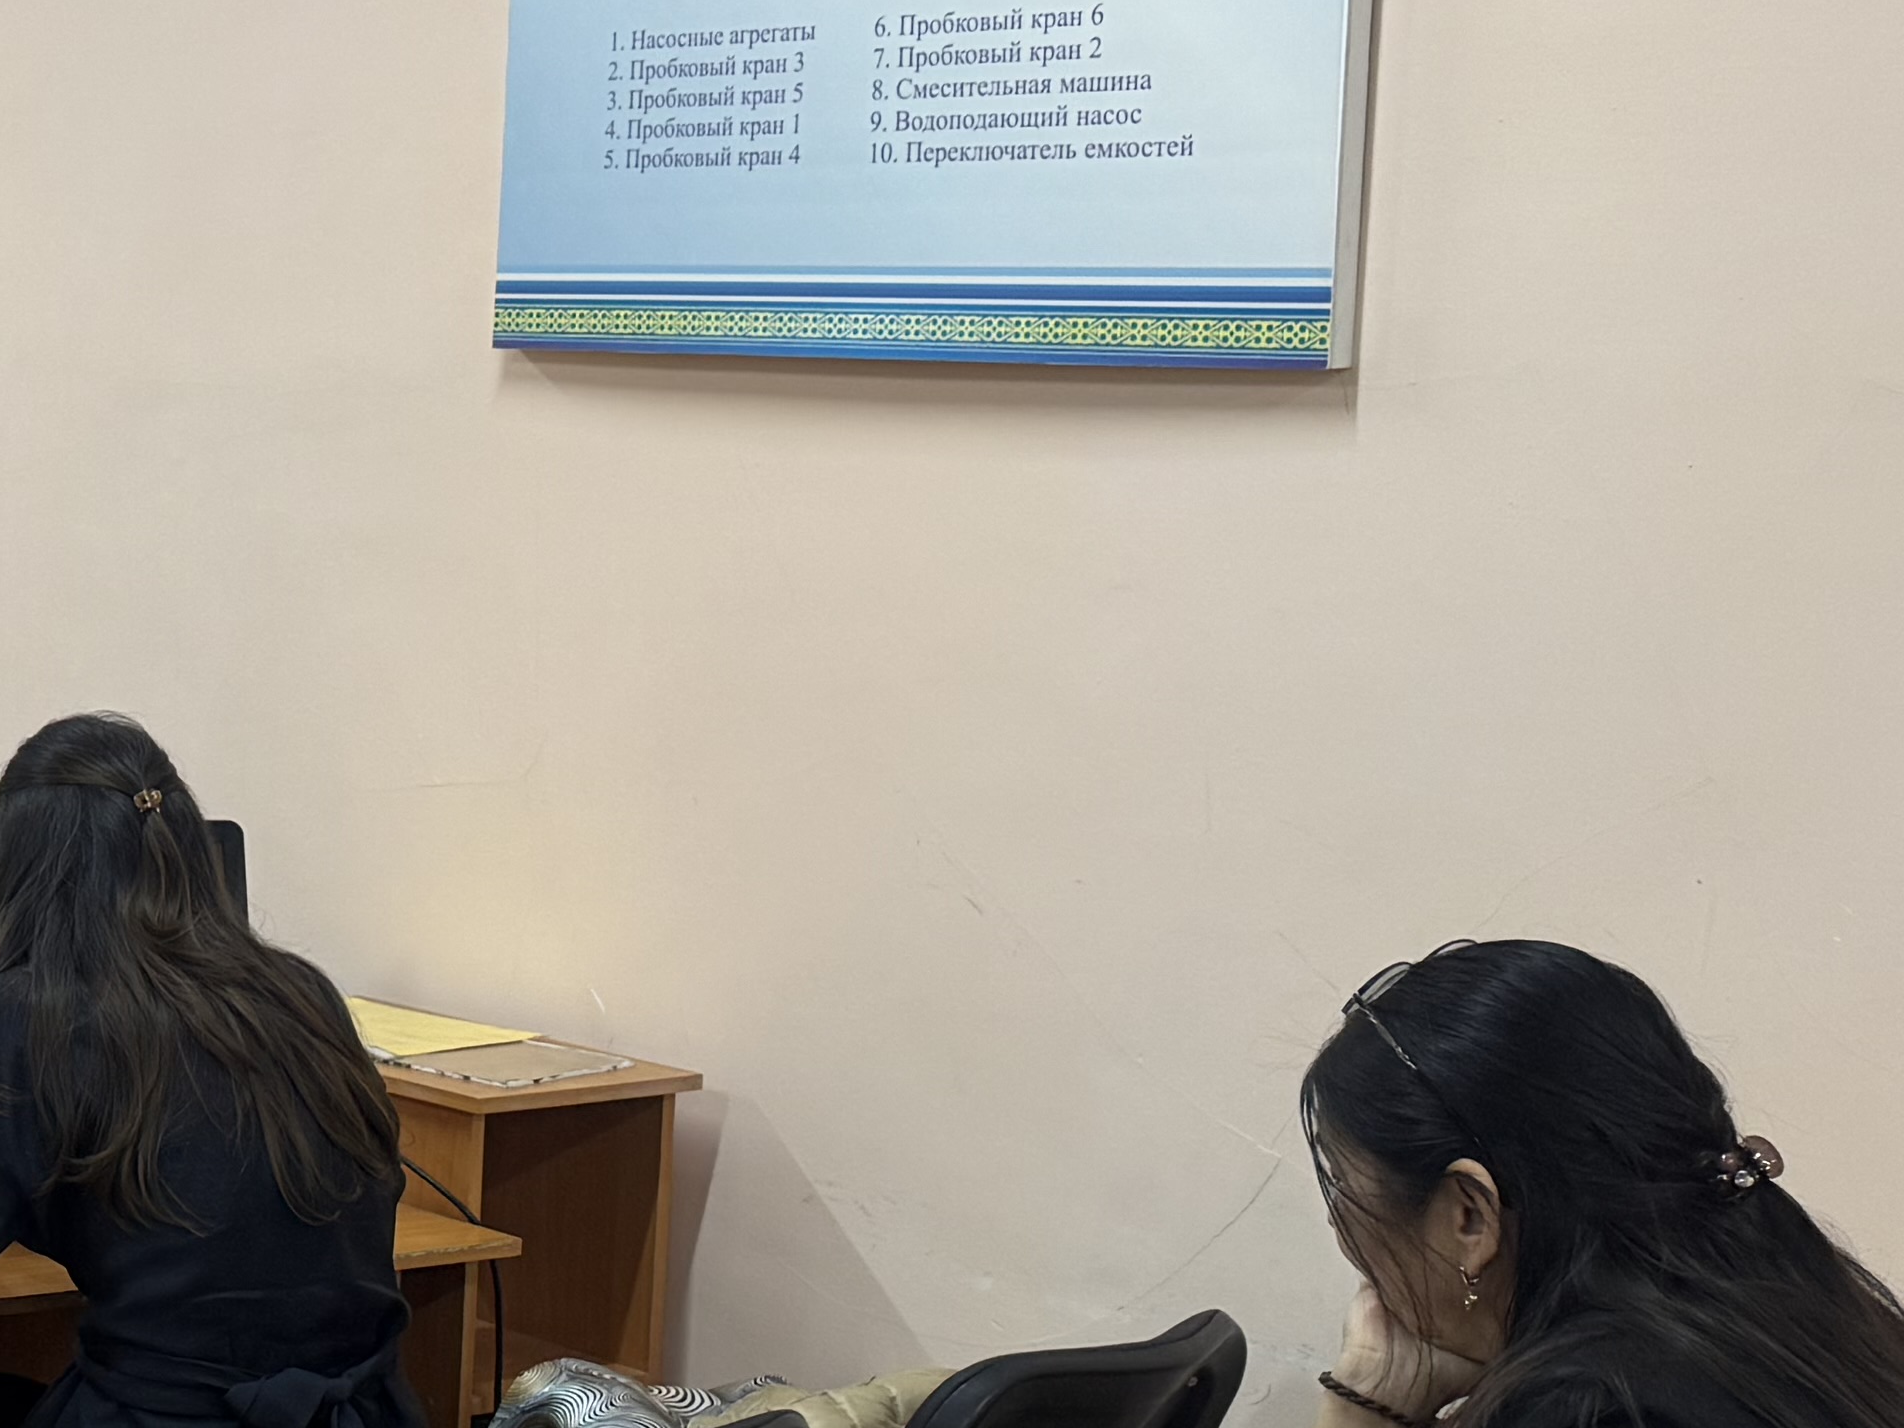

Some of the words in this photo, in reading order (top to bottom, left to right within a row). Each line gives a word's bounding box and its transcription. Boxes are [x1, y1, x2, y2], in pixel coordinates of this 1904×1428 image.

[874, 15, 892, 38] 6.
[899, 7, 1023, 41] Пробковый
[1030, 10, 1083, 35] кран
[1091, 2, 1104, 26] 6
[611, 31, 625, 52] 1.
[631, 30, 724, 51] Насосные
[729, 25, 816, 49] агрегаты
[873, 47, 890, 69] 7.
[897, 41, 1022, 72] Пробковый
[1029, 43, 1082, 67] кран
[1088, 36, 1103, 59] 2
[608, 61, 623, 81] 2.
[630, 55, 736, 85] Пробковый
[742, 57, 787, 80] кран
[793, 51, 805, 73] 3
[607, 90, 622, 111] 3.
[628, 85, 735, 114] Пробковый
[740, 88, 786, 110] кран
[792, 82, 804, 103] 5
[871, 78, 889, 100] 8.
[895, 75, 1052, 100] Смесительная
[1059, 73, 1152, 94] машина
[604, 120, 621, 140] 4.
[627, 116, 733, 144] Пробковый
[739, 119, 784, 141] кран
[792, 113, 800, 134] 1
[870, 111, 888, 132] 9.
[895, 104, 1068, 132] Водоподающий
[1076, 107, 1143, 127] насос
[603, 149, 619, 169] 5.
[625, 146, 732, 174] Пробковый
[737, 149, 783, 171] кран
[788, 144, 800, 164] 4
[871, 142, 898, 164] 10.
[906, 139, 1077, 168] Переключатель
[1084, 134, 1194, 159] емкостей
